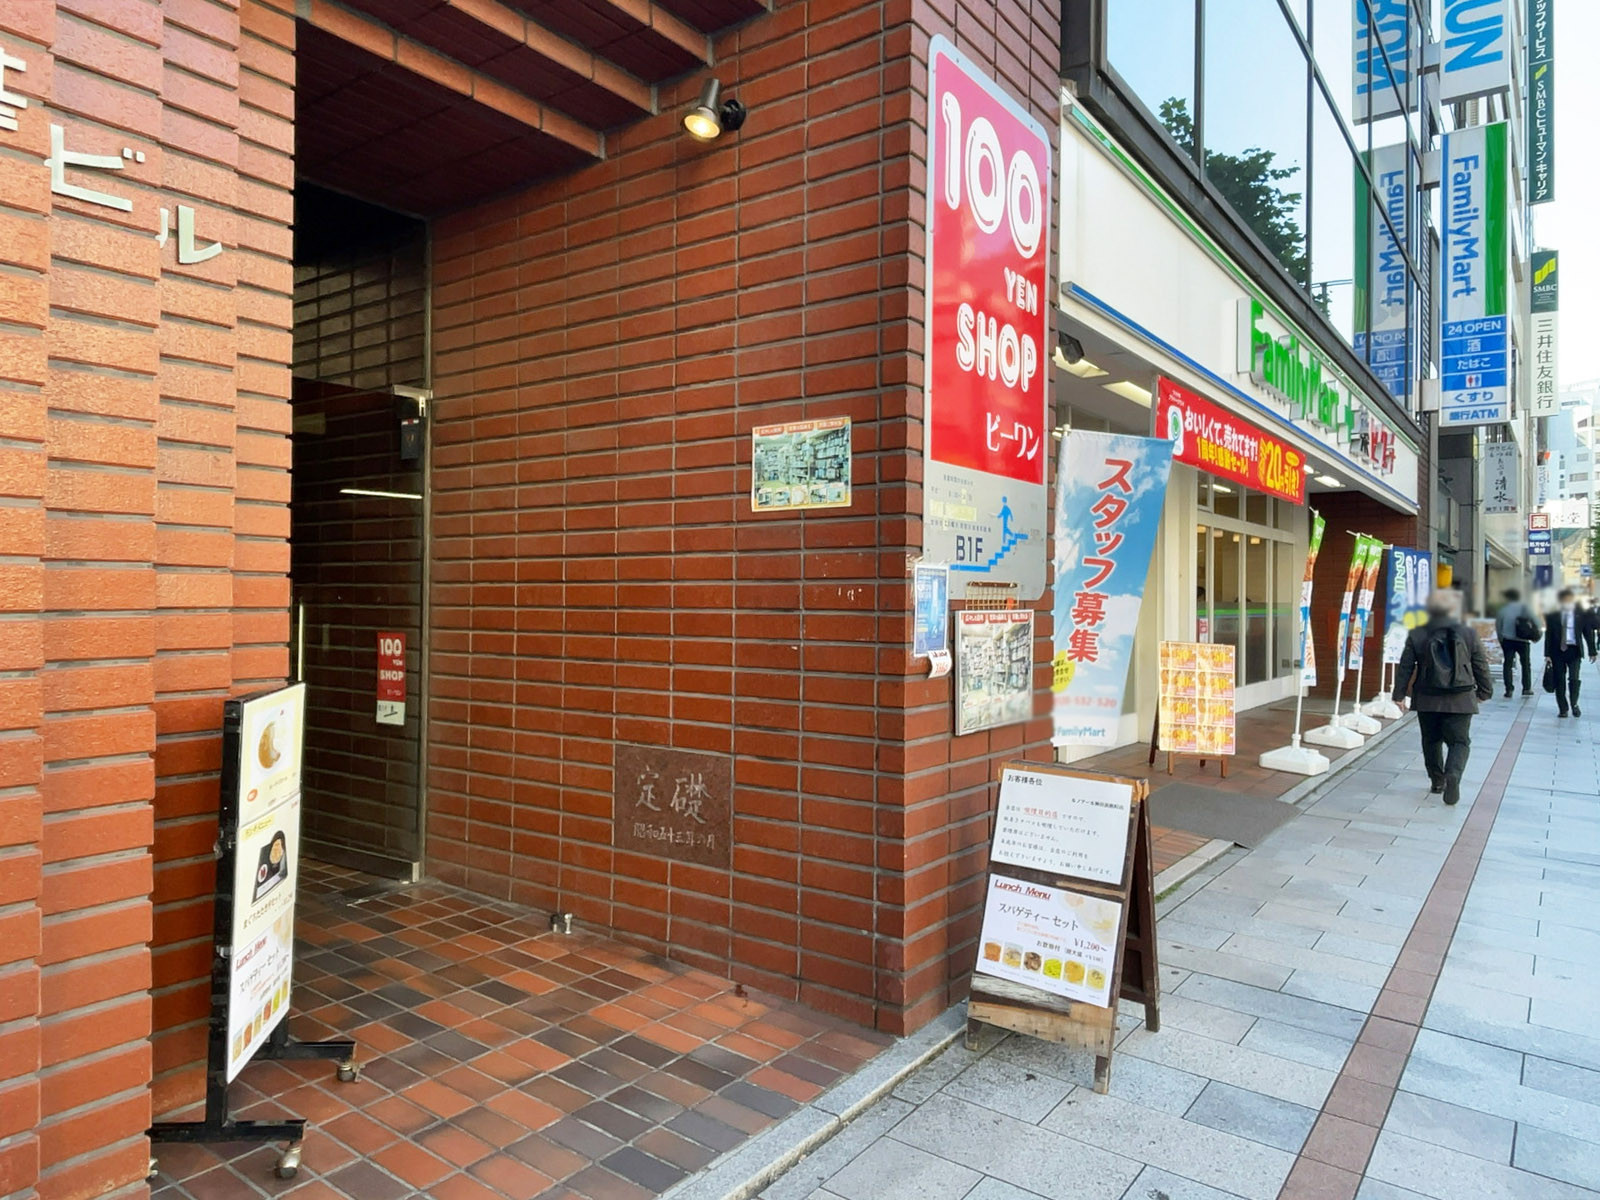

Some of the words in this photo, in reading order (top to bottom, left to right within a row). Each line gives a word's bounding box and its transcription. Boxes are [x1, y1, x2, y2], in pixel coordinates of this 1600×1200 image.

[1444, 0, 1504, 73] UN
[942, 91, 1042, 260] 100
[1449, 155, 1479, 298] FamilyMart
[1004, 266, 1037, 316] YEN
[1533, 284, 1557, 292] SMBC
[1448, 325, 1462, 335] 24
[1464, 320, 1501, 333] OPEN
[956, 302, 1037, 393] SHOP
[1467, 339, 1481, 352] 酒
[1250, 298, 1354, 443] FamilyMart
[1457, 358, 1491, 369] たばこ
[1537, 318, 1553, 409] 三井住友銀行
[1455, 391, 1493, 402] くすり
[1450, 408, 1498, 420] 銀行ATM
[956, 535, 983, 562] B1F
[1067, 458, 1134, 663] スタッフ募集
[380, 638, 402, 656] 100
[380, 669, 404, 681] SHOP
[1007, 774, 1043, 786] お客様各位
[635, 764, 713, 825] 定礎
[994, 879, 1022, 893] Lunch
[1025, 886, 1051, 900] Menu
[1053, 916, 1079, 931] セット
